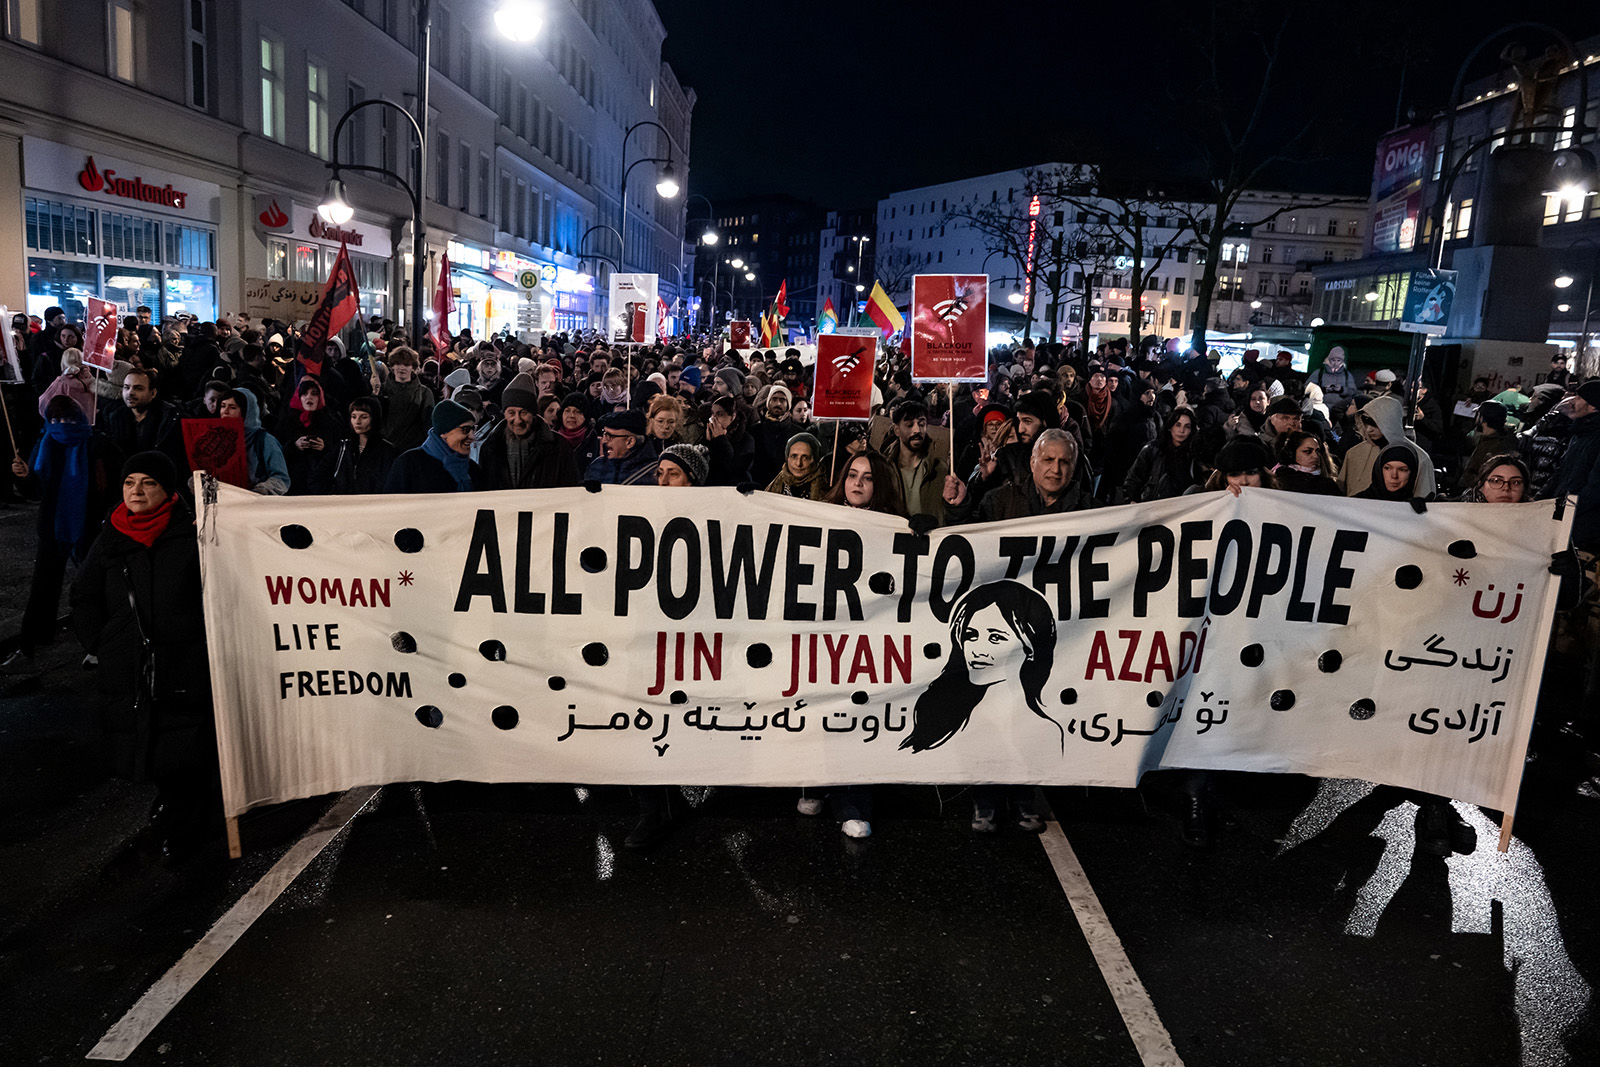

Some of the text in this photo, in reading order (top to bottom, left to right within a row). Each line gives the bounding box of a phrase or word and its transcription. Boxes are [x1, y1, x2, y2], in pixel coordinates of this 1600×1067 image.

[1384, 140, 1425, 172] OMG!
[103, 169, 188, 209] Santander
[300, 290, 319, 306] زن
[1325, 279, 1357, 292] KARSTADT
[453, 508, 1369, 626] ALL POWER TO THE PEOPLE
[273, 623, 341, 651] LIFE
[647, 615, 1212, 698] JIN JIYAN AZADÎ
[1384, 633, 1514, 684] زندگی
[279, 669, 413, 700] FREEDOM
[822, 703, 908, 743] ناوت
[1195, 691, 1230, 735] تۆ
[1408, 701, 1506, 744] آزادی
